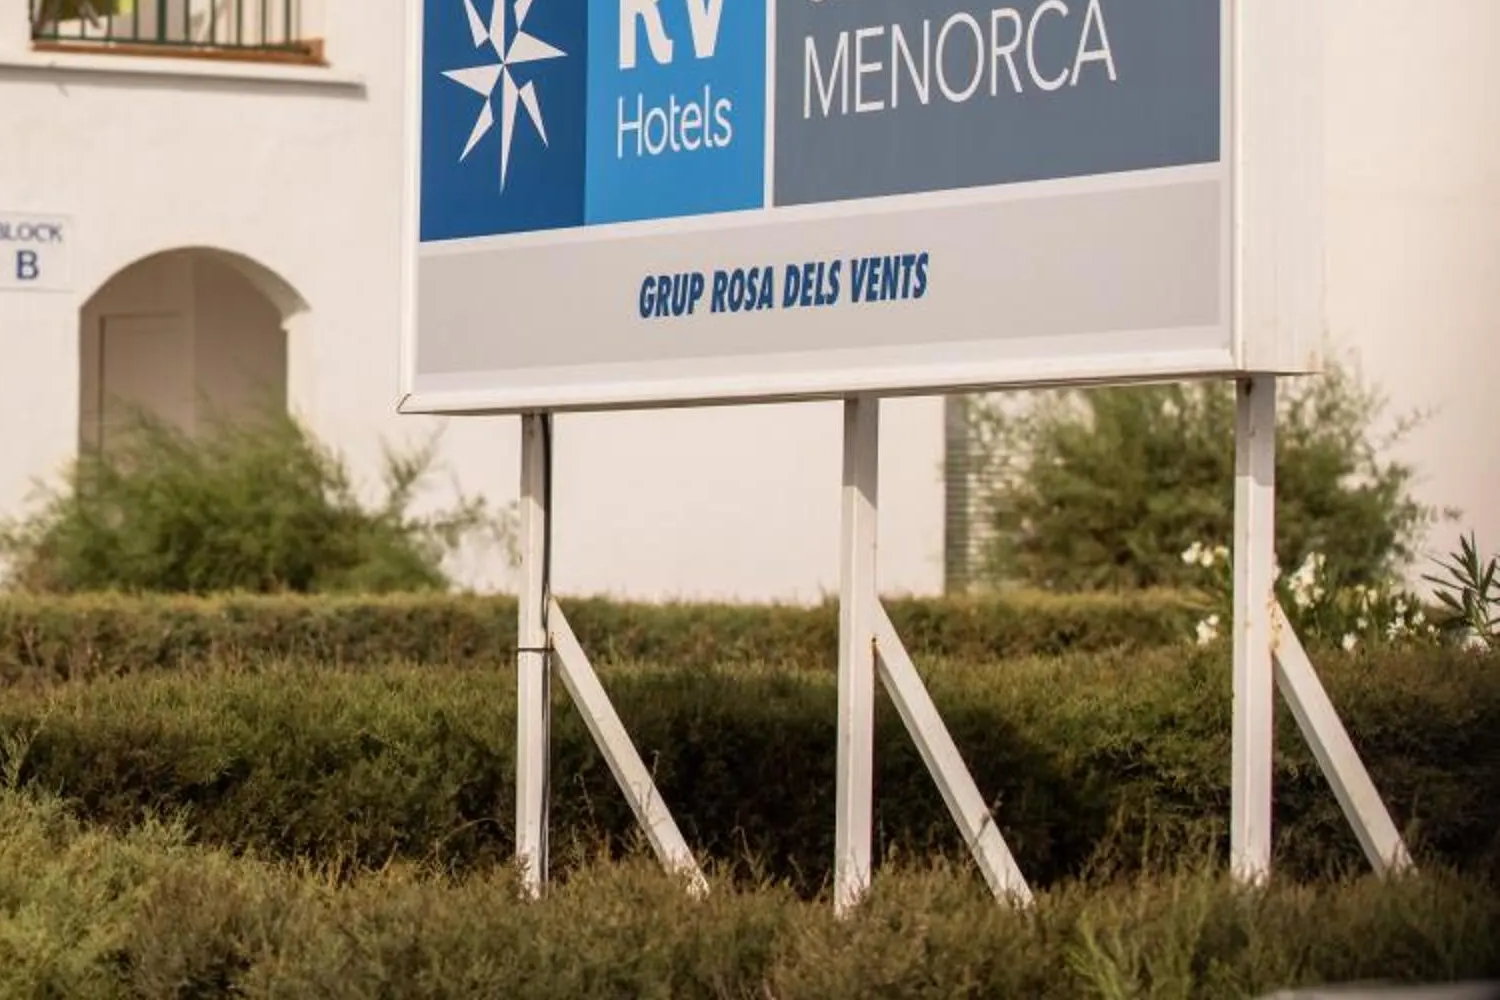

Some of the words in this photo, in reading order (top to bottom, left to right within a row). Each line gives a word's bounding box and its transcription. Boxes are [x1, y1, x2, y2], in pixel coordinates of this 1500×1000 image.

[616, 85, 733, 159] Hotels
[16, 249, 39, 280] B
[638, 272, 705, 319] GRUP
[710, 266, 775, 313] ROSA
[782, 260, 842, 308] DELS
[849, 252, 930, 302] VENTS
